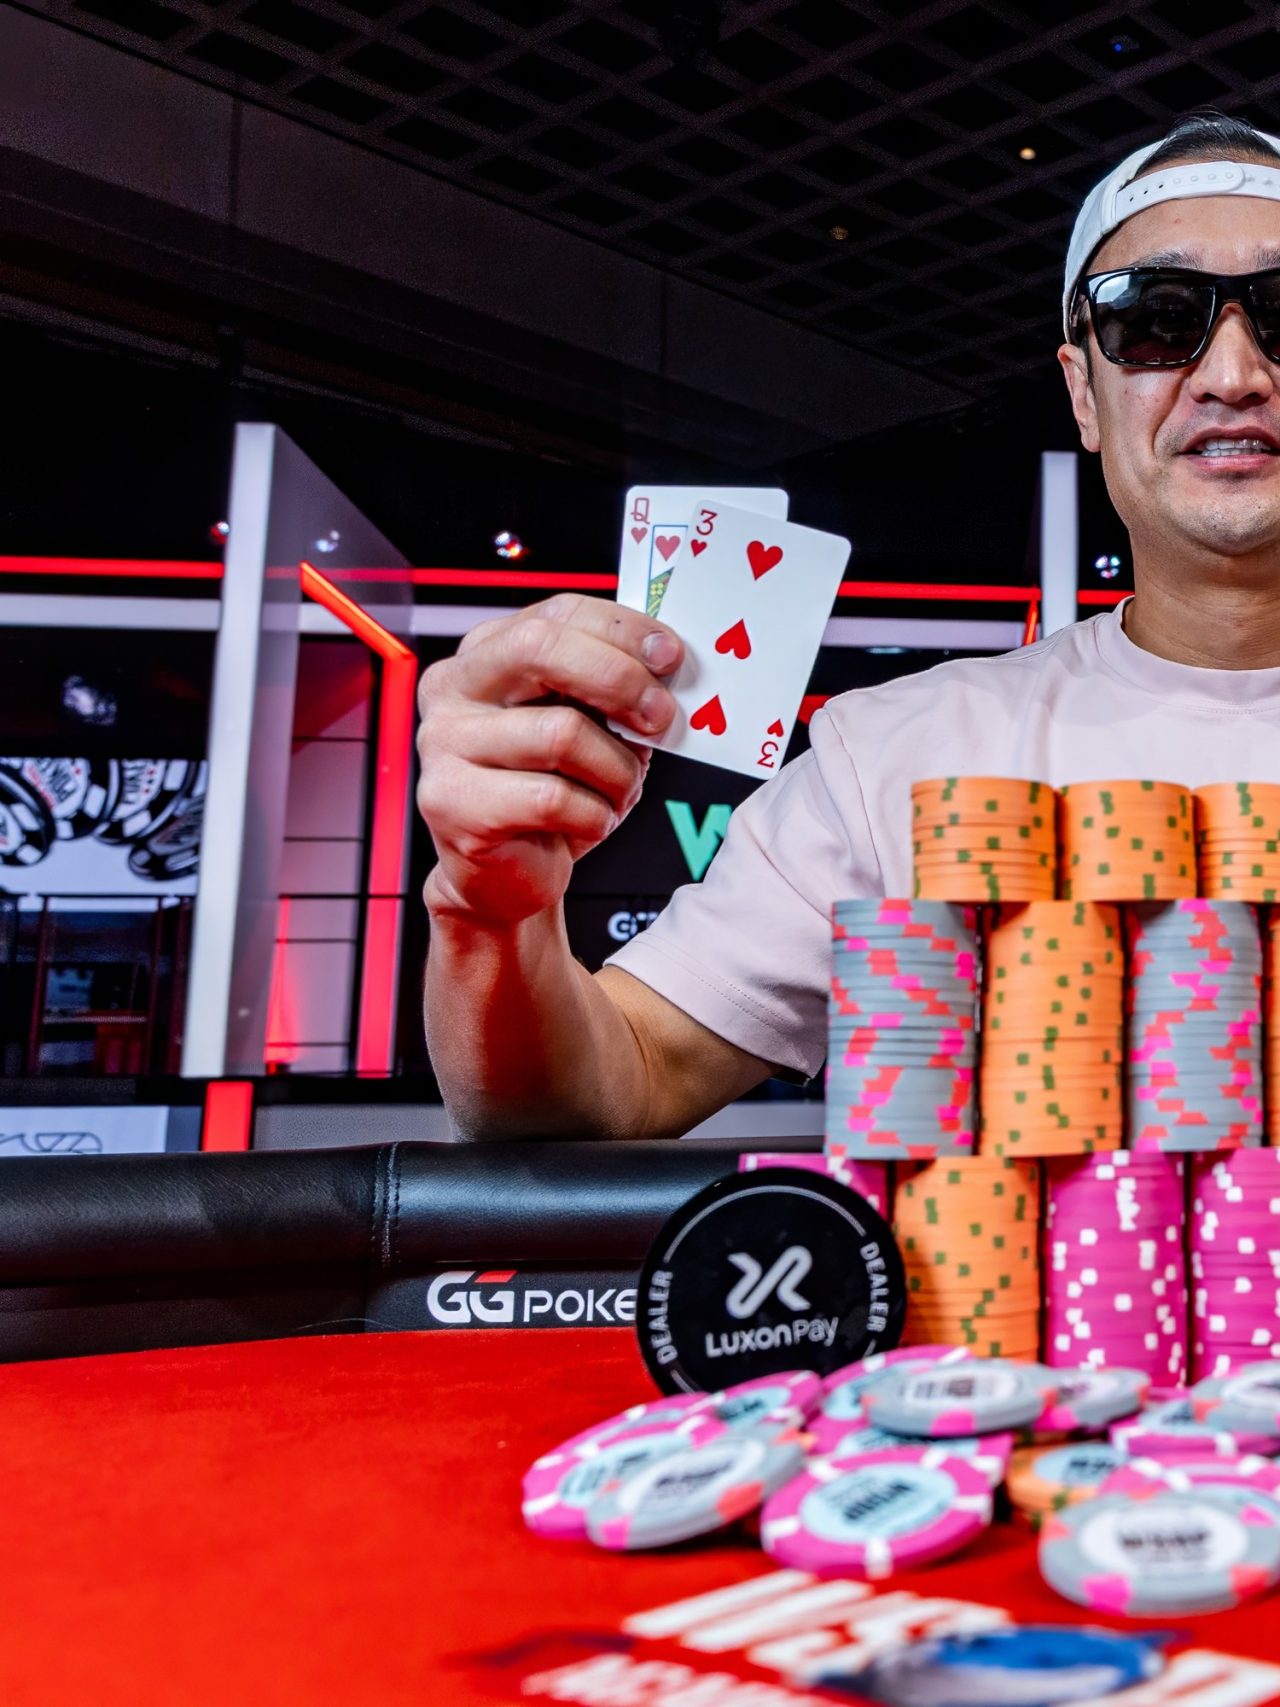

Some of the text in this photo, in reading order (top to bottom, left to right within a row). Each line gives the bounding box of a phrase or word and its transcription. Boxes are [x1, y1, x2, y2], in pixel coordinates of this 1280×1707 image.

[630, 497, 650, 524] Q
[695, 509, 718, 536] 3
[756, 741, 779, 768] 3
[426, 1270, 638, 1324] GG POKE
[860, 1241, 890, 1333] DEALER
[648, 1270, 679, 1375] DEALER
